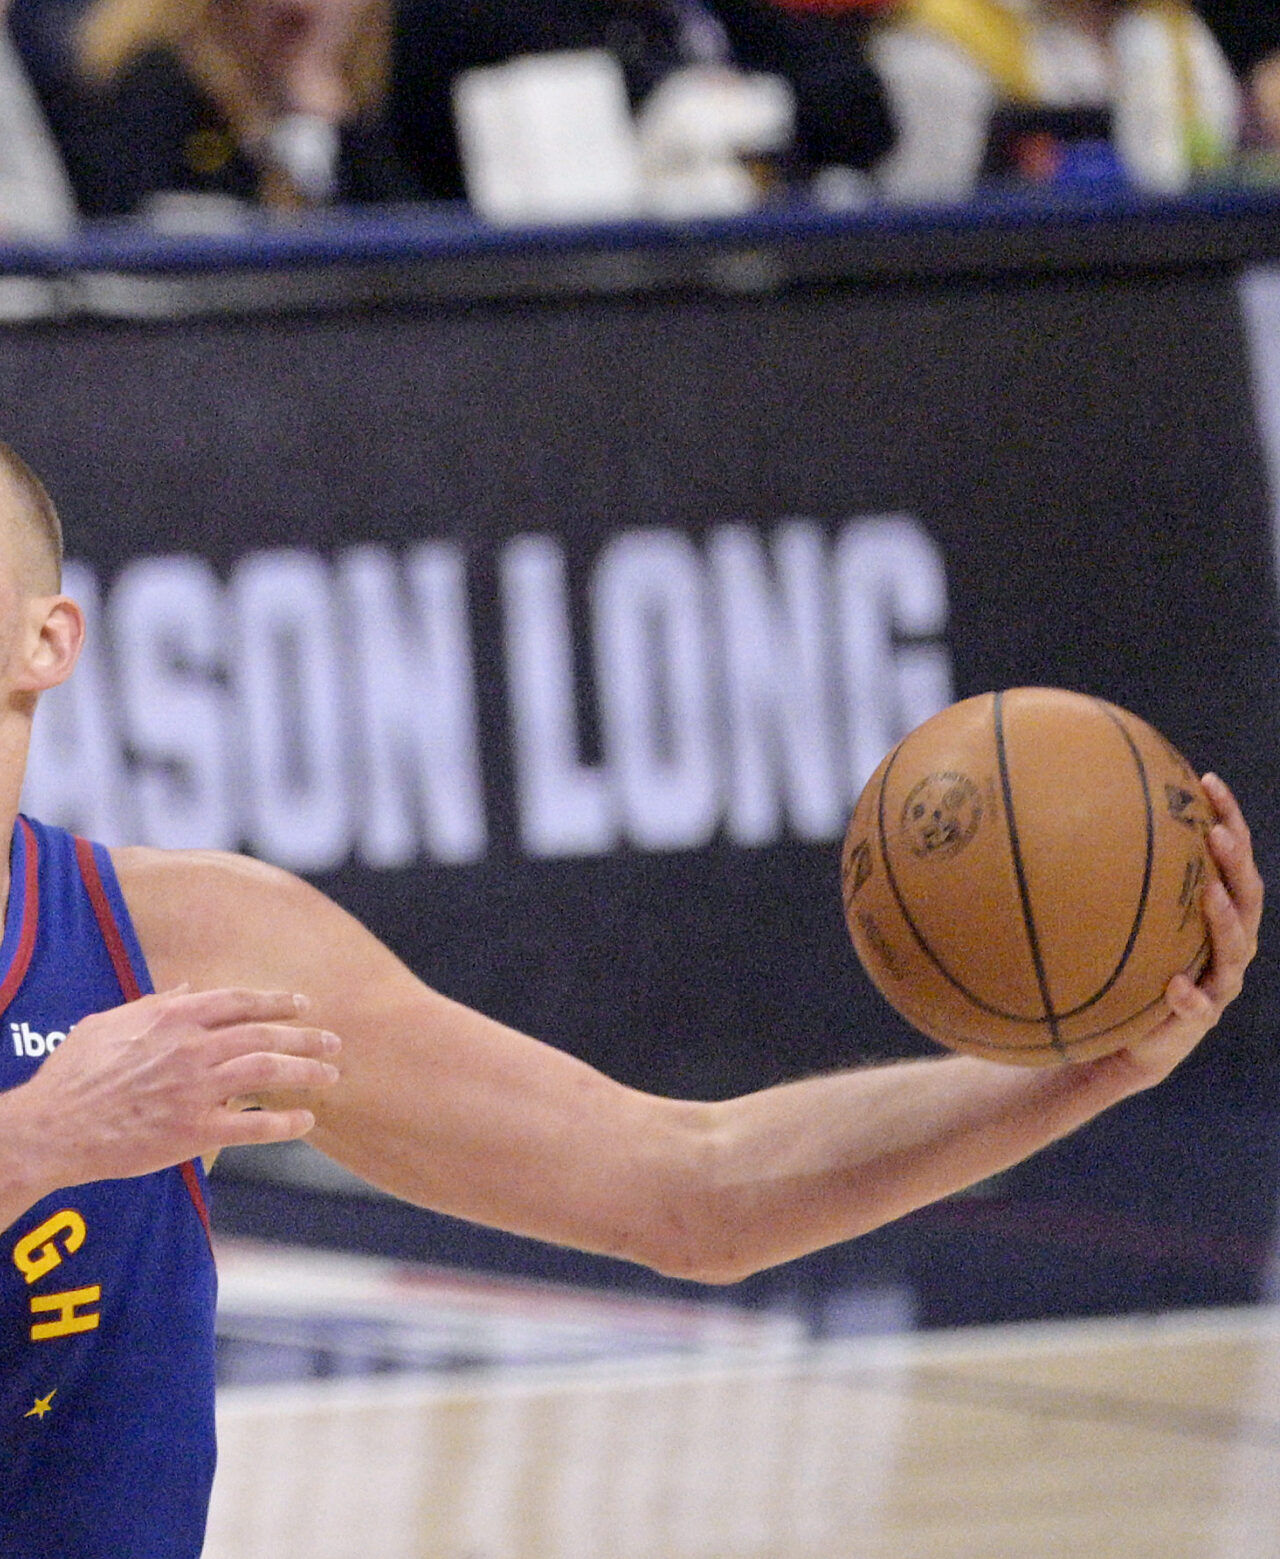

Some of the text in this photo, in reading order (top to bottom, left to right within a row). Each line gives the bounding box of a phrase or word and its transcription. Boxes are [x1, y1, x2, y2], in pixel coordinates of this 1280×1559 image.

[16, 540, 486, 868] ASON
[500, 514, 954, 857] LONG
[10, 1022, 74, 1057] ibo
[13, 1208, 101, 1341] GH
